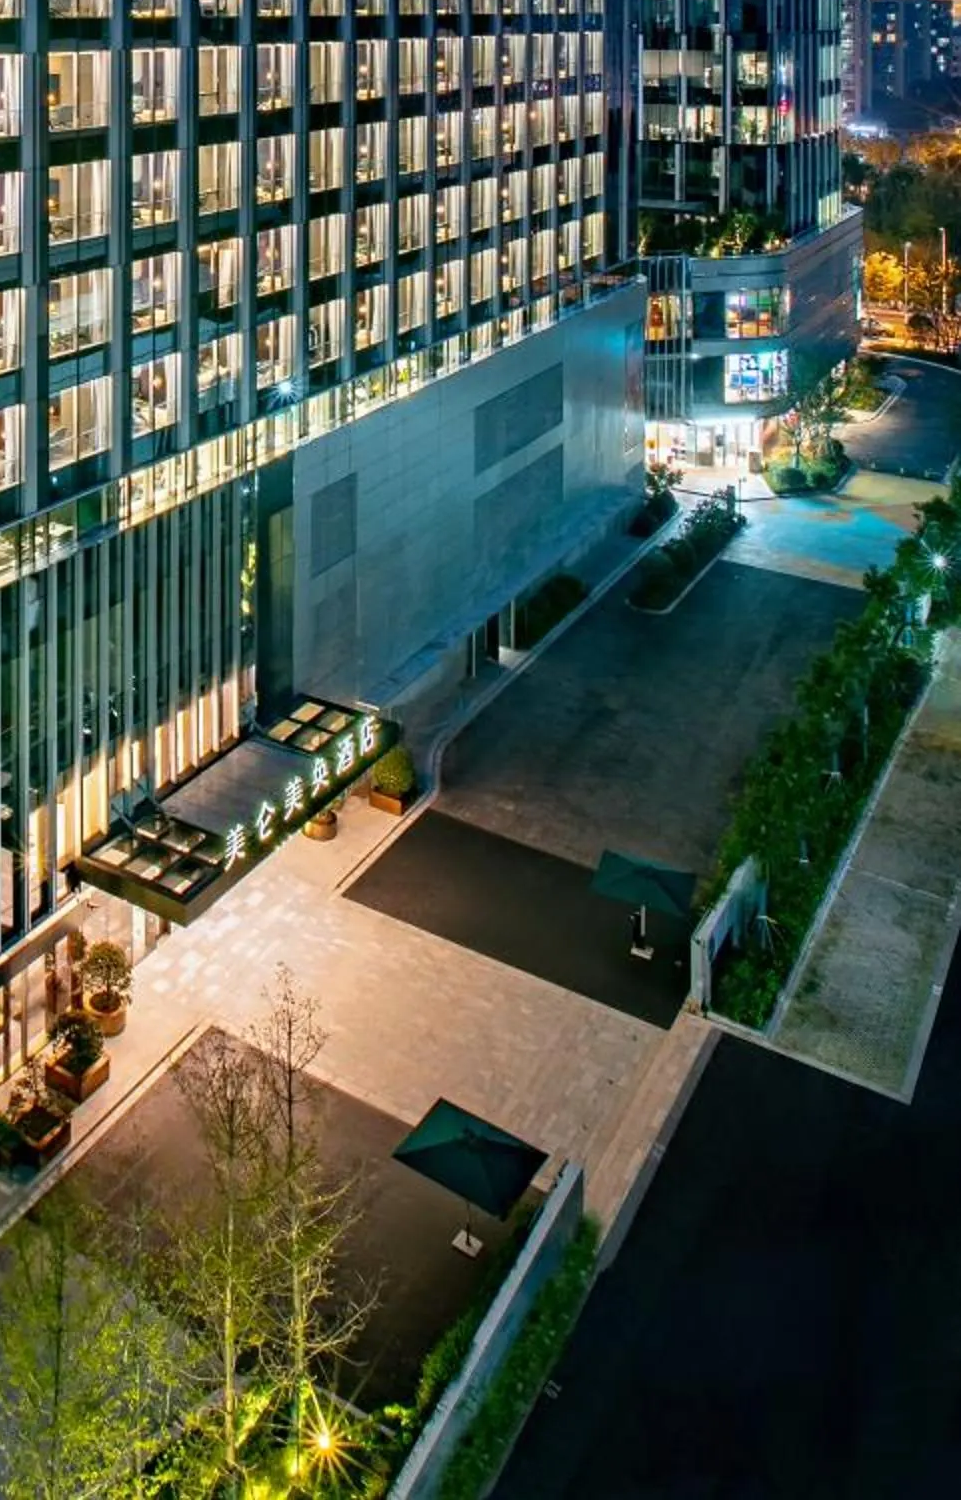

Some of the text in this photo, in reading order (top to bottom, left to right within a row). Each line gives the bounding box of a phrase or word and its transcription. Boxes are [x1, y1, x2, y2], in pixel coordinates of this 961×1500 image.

[223, 715, 378, 872] 美仑美奂酒店
